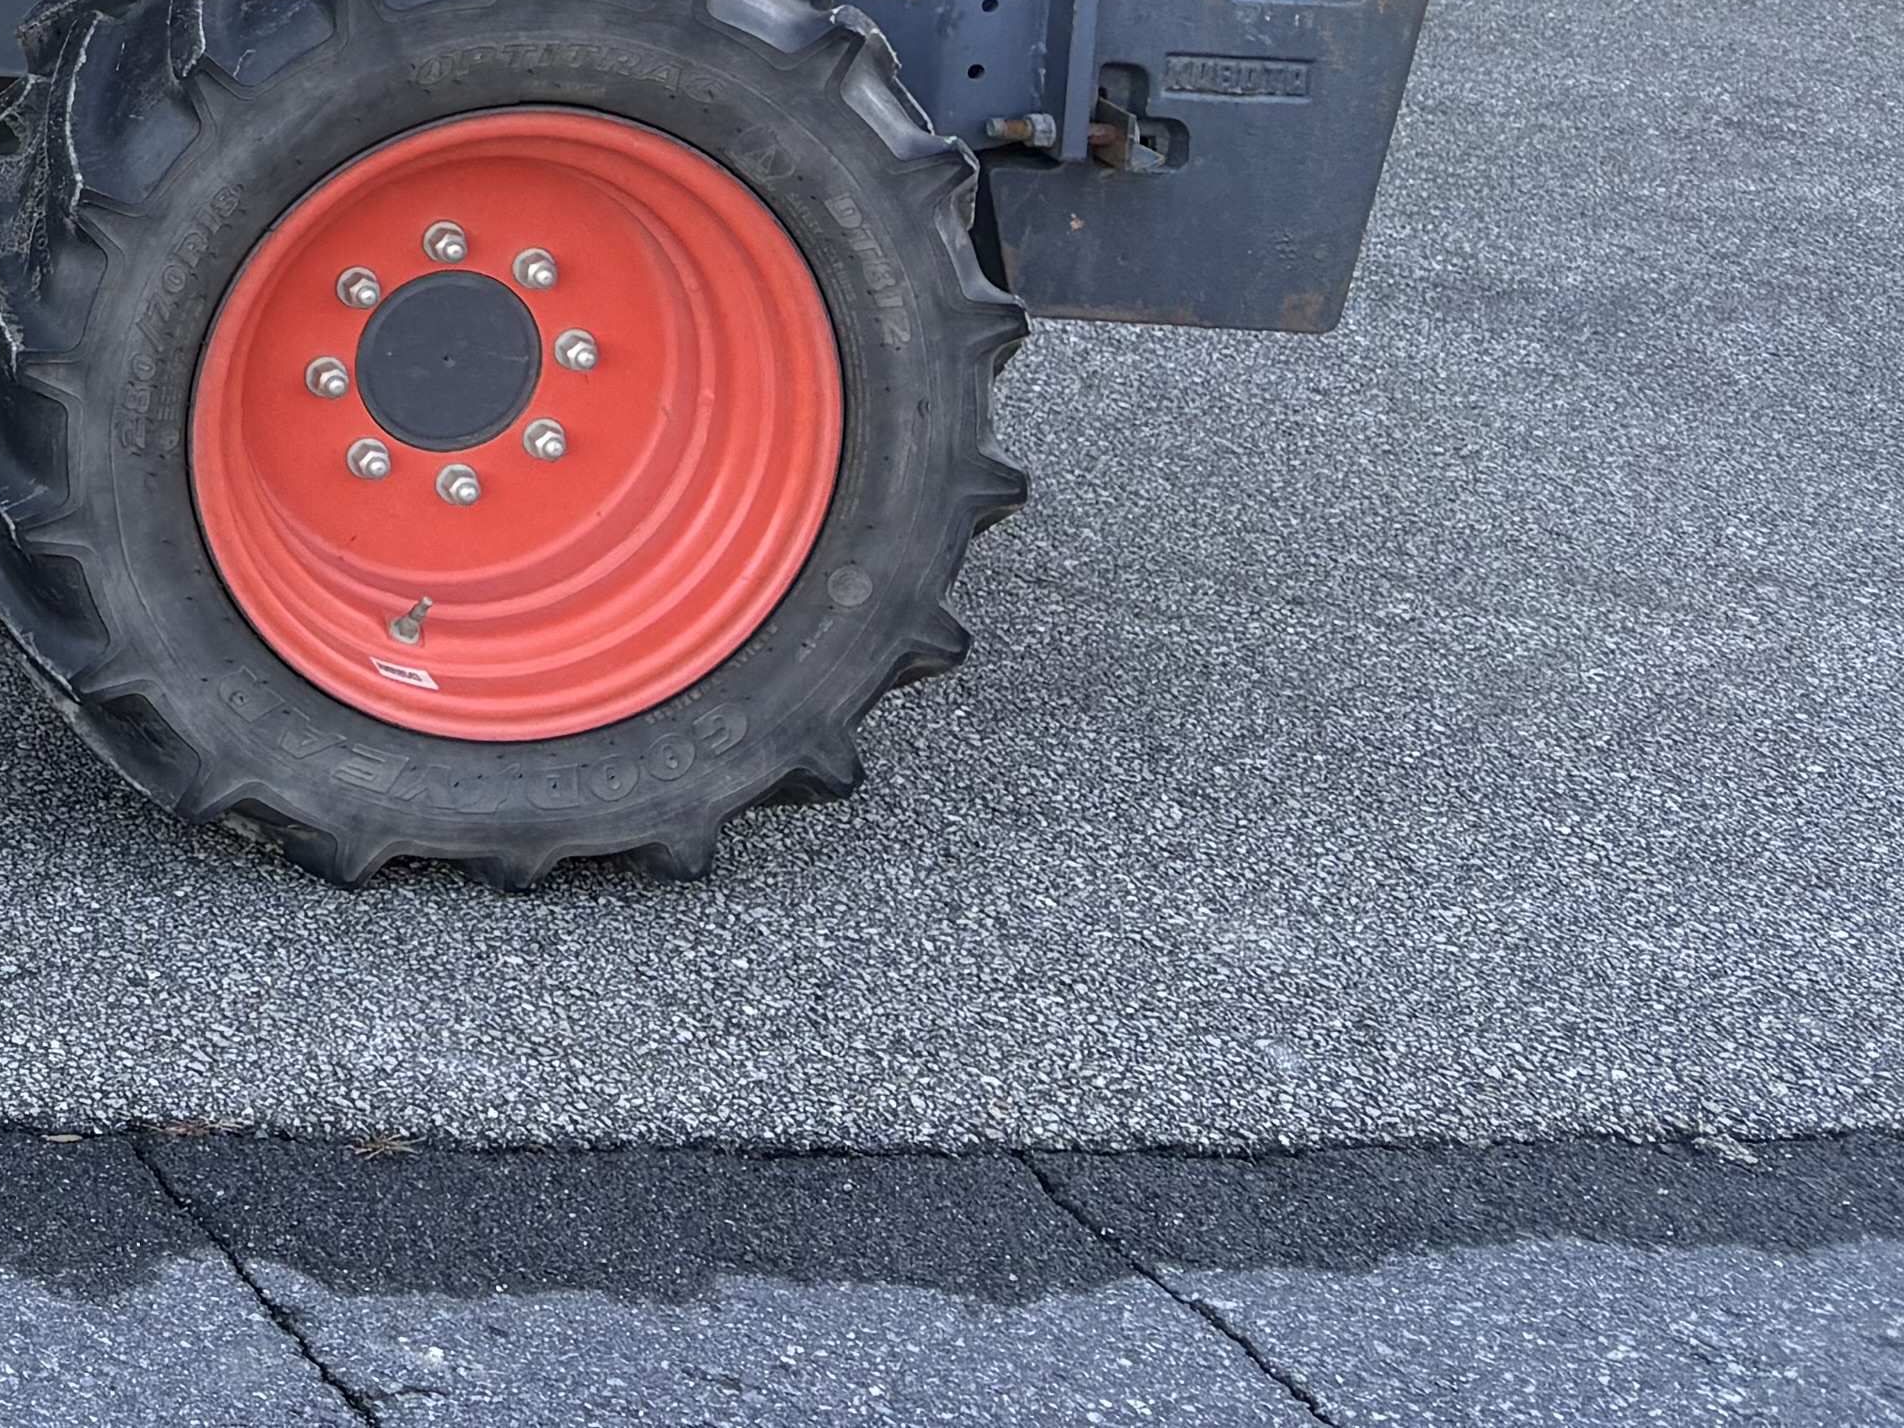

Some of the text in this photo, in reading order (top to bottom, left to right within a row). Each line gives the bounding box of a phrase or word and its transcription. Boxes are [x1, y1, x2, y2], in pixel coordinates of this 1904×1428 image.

[412, 43, 728, 104] OPTITRAC
[823, 191, 915, 345] DT812
[216, 665, 748, 814] GOODYEAR
